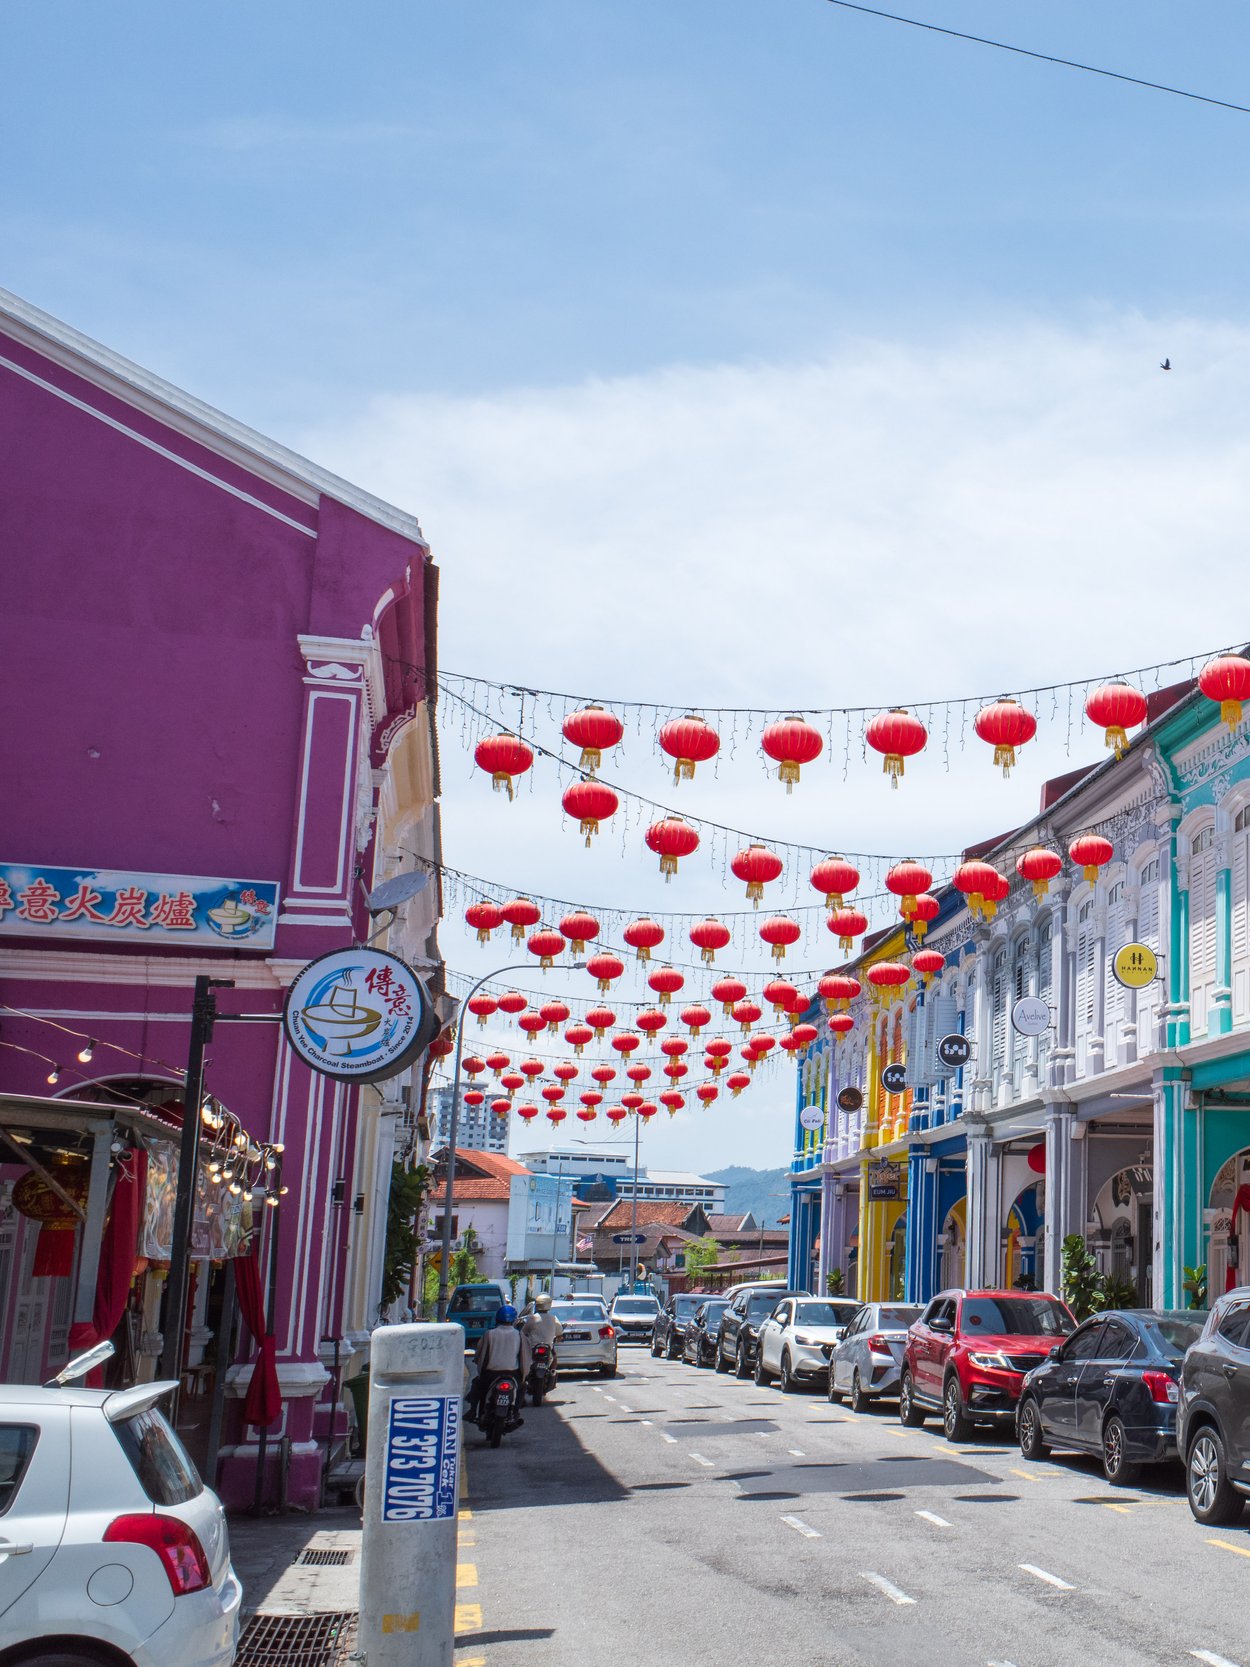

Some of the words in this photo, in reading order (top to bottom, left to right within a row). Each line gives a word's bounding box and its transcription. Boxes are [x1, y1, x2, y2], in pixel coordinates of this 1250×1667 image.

[292, 1010, 301, 1035] Chuan
[299, 1034, 308, 1049] Yee
[307, 1047, 340, 1068] Charcoal
[340, 1054, 385, 1069] Steamboat
[387, 1035, 406, 1055] Since
[403, 1015, 415, 1035] 2014
[393, 1400, 440, 1429] 017
[445, 1400, 458, 1453] LOAN
[390, 1435, 438, 1469] 373
[448, 1456, 456, 1489] Tukar
[386, 1473, 435, 1520] 7076
